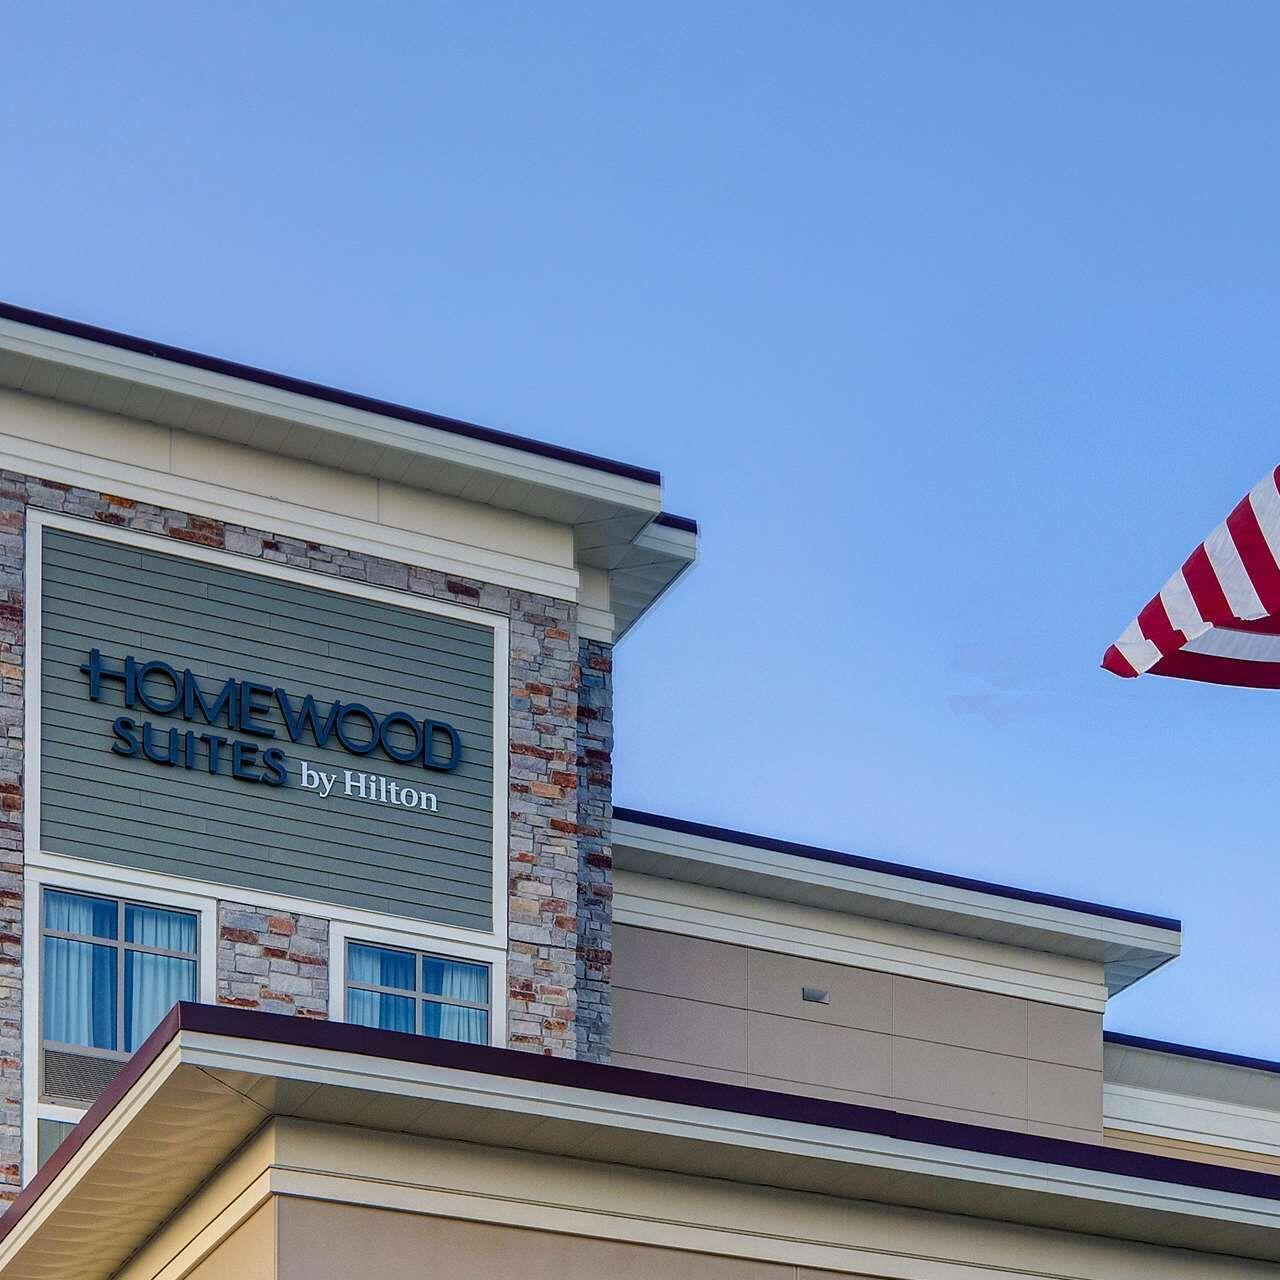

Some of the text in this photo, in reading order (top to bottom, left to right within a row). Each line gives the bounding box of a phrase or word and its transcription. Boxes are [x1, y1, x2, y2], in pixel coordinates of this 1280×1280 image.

[79, 648, 462, 772] HOMEWOOD
[111, 716, 439, 812] SUITES by Hilton
